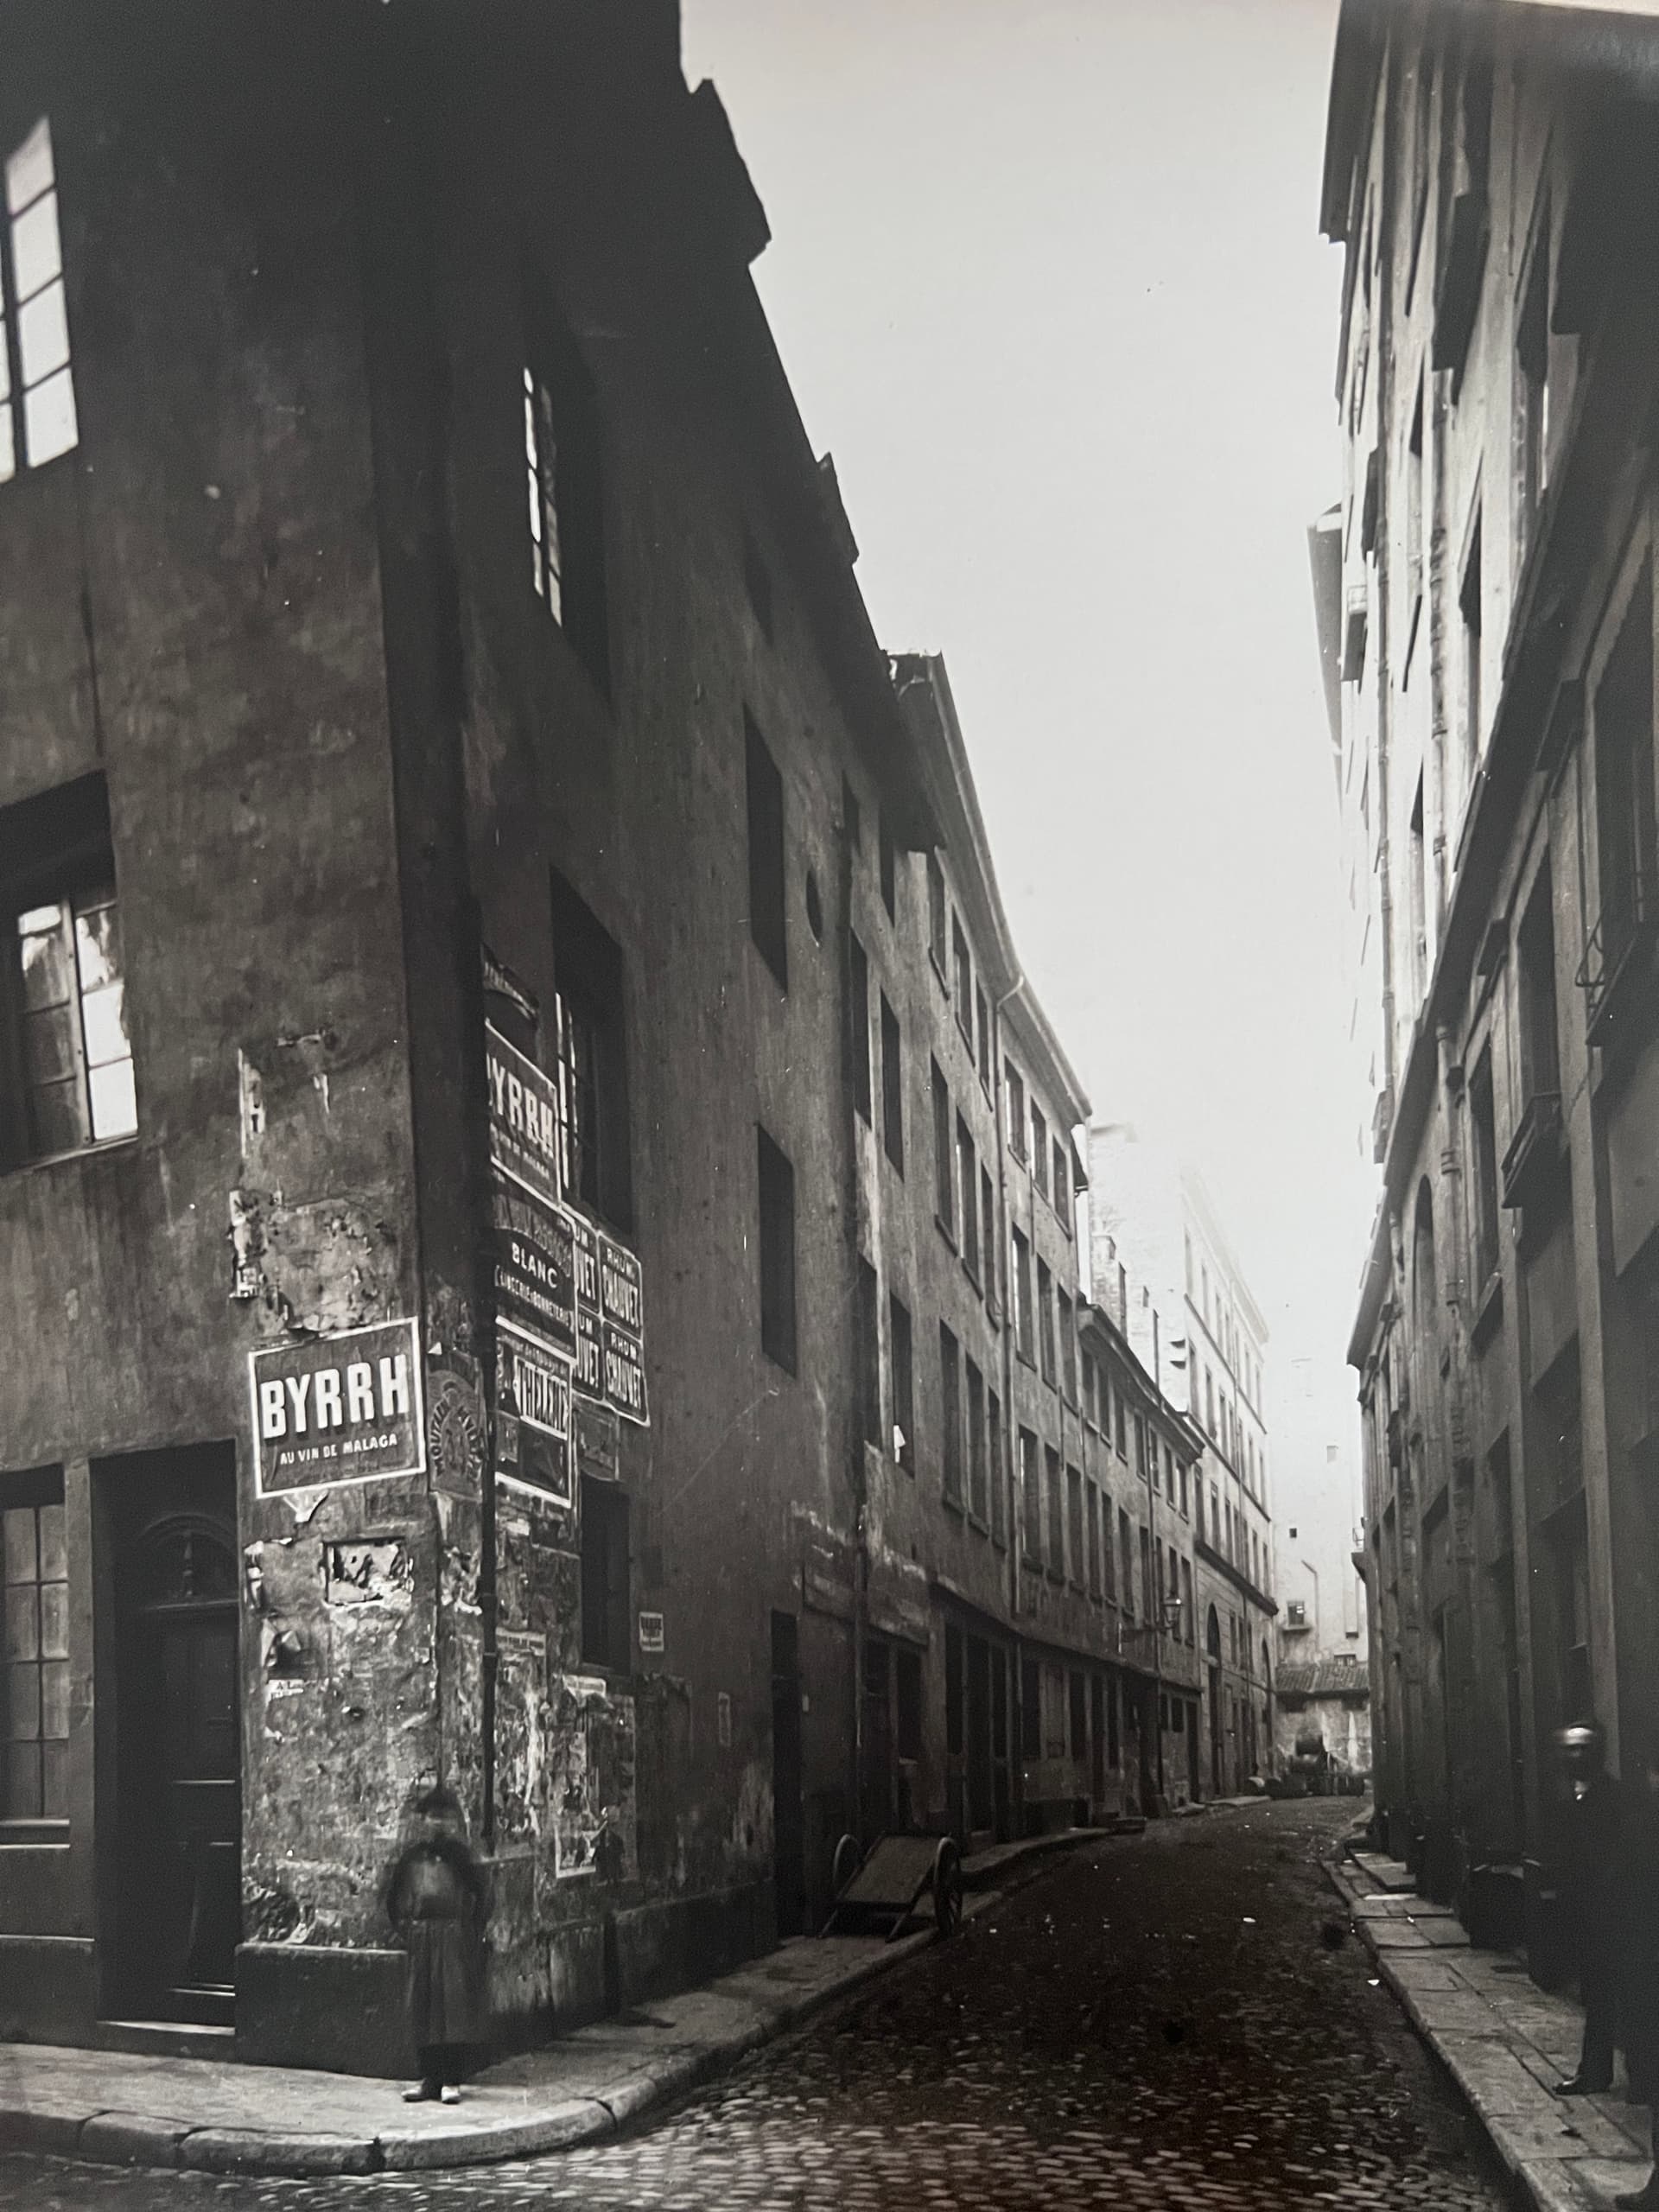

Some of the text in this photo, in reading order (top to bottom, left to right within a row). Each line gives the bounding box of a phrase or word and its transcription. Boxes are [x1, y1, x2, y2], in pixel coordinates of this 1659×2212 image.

[512, 1242, 558, 1289] BLANC
[607, 1247, 636, 1280] RHUM
[579, 1314, 593, 1335] UM
[610, 1332, 637, 1360] RHUM
[260, 1353, 410, 1440] BYRRH
[279, 1433, 398, 1465] AU VIN DE MALAGA
